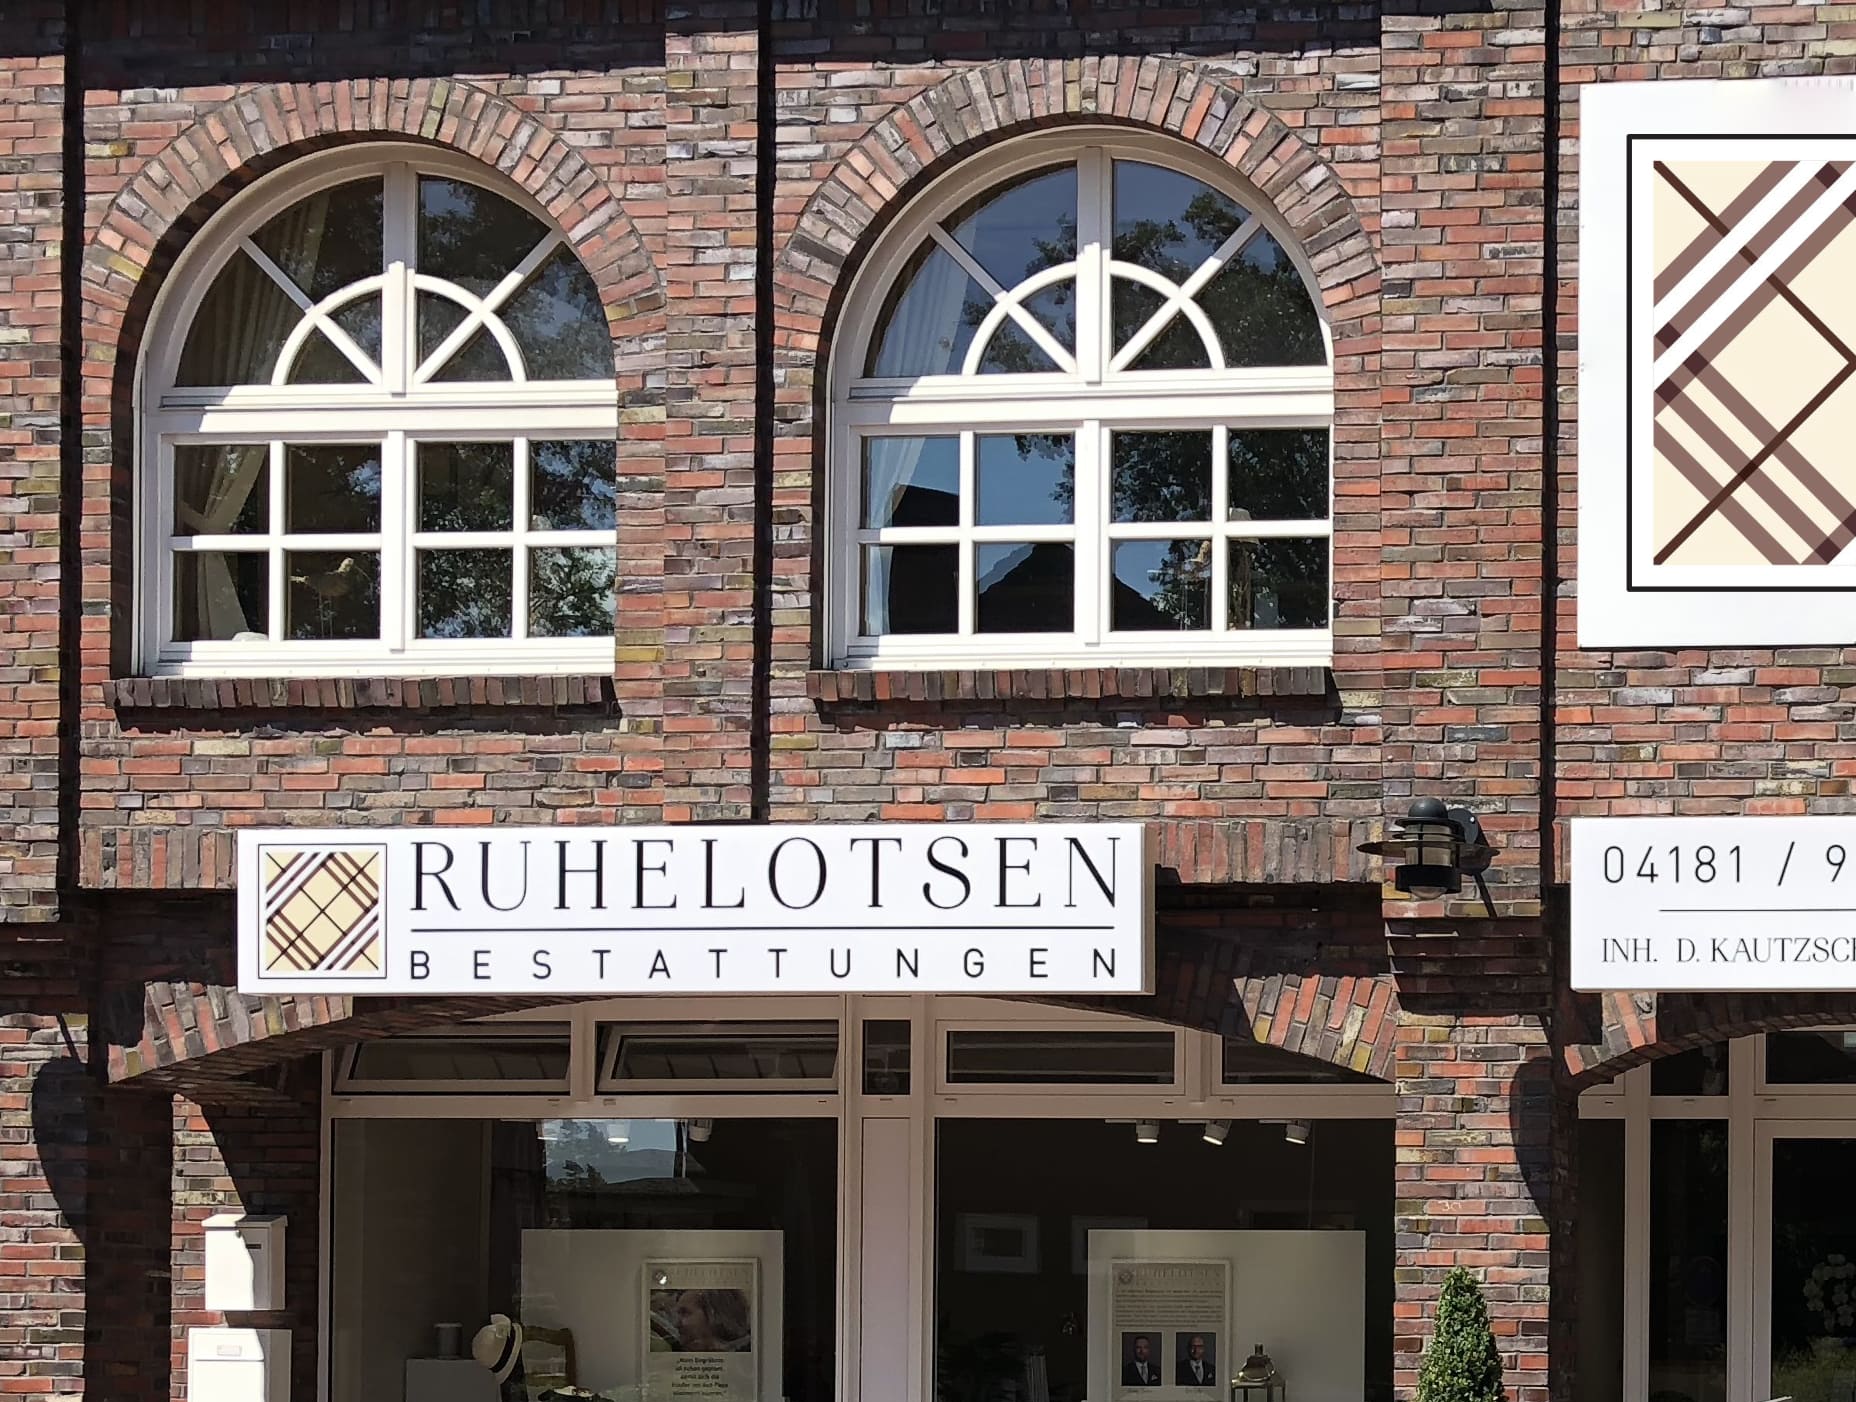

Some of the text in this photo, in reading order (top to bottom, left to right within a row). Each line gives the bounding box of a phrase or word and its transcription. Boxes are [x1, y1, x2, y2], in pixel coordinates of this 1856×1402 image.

[411, 836, 1120, 912] RUHELOTSEN
[1604, 845, 1741, 884] 04181
[1777, 840, 1796, 887] /
[411, 947, 1116, 980] BESTATTUNGEN
[1602, 937, 1658, 963] INH.
[1677, 938, 1700, 963] D.
